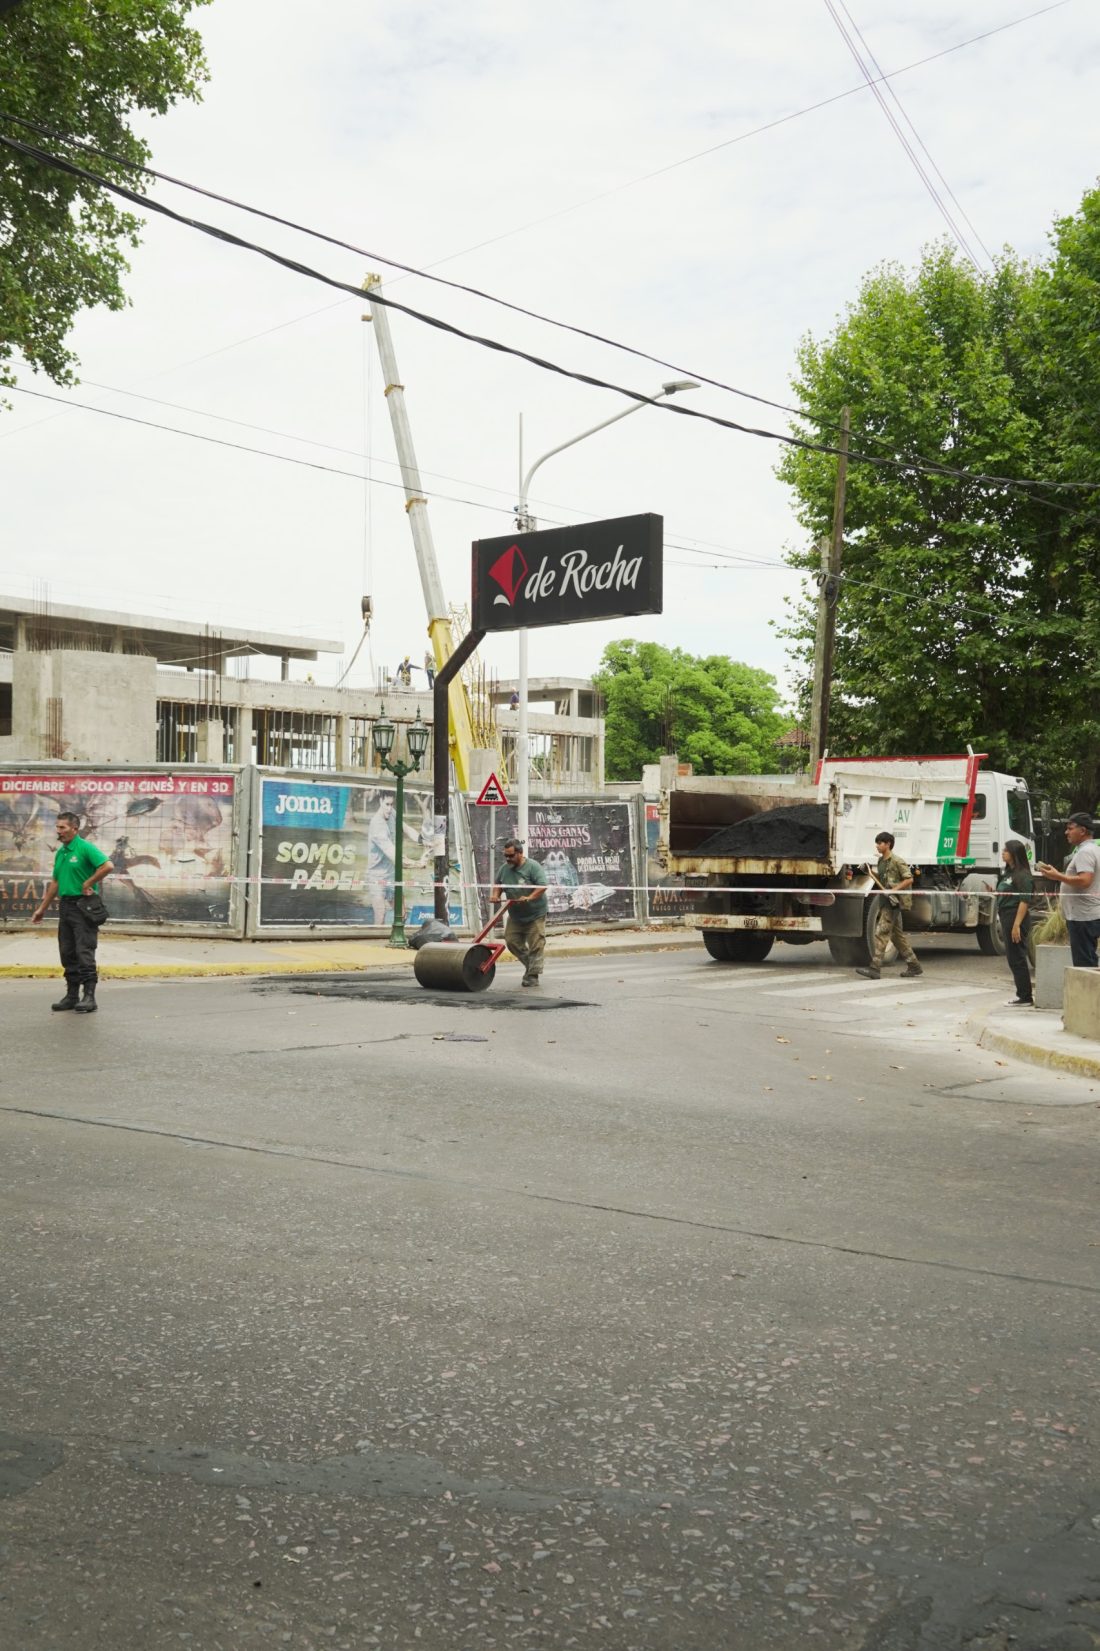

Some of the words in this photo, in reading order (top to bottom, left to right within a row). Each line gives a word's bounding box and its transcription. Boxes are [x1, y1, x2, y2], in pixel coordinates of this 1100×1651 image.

[524, 556, 556, 603] de
[559, 544, 643, 599] Rocha
[2, 781, 65, 791] DICIEMBRE
[80, 781, 114, 791] SOLO
[118, 781, 134, 791] EN
[138, 781, 174, 792] CINES
[178, 782, 187, 792] Y
[190, 782, 208, 792] EN
[211, 782, 229, 793] 3D
[894, 809, 910, 824] AV
[513, 826, 557, 839] ERAÑAS
[943, 837, 954, 848] 217
[275, 841, 358, 865] SOMOS
[290, 864, 364, 891] PÁDEL
[11, 903, 60, 911] CENIAS
